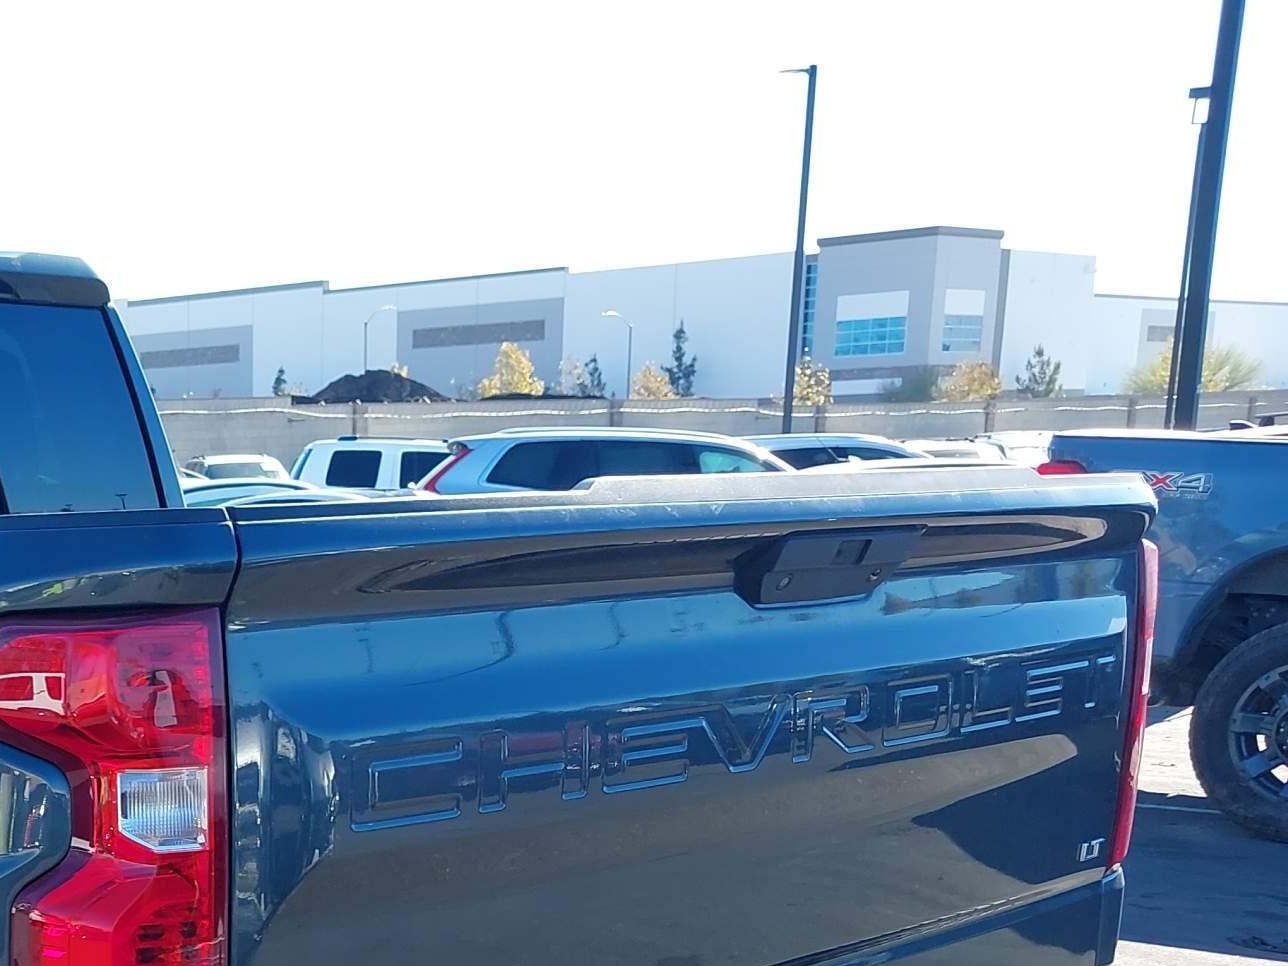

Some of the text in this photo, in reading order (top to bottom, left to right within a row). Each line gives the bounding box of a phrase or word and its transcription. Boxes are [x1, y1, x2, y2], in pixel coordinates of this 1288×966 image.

[1141, 471, 1213, 495] X4
[349, 653, 1117, 833] CHEVROLET
[1079, 838, 1105, 862] LT
